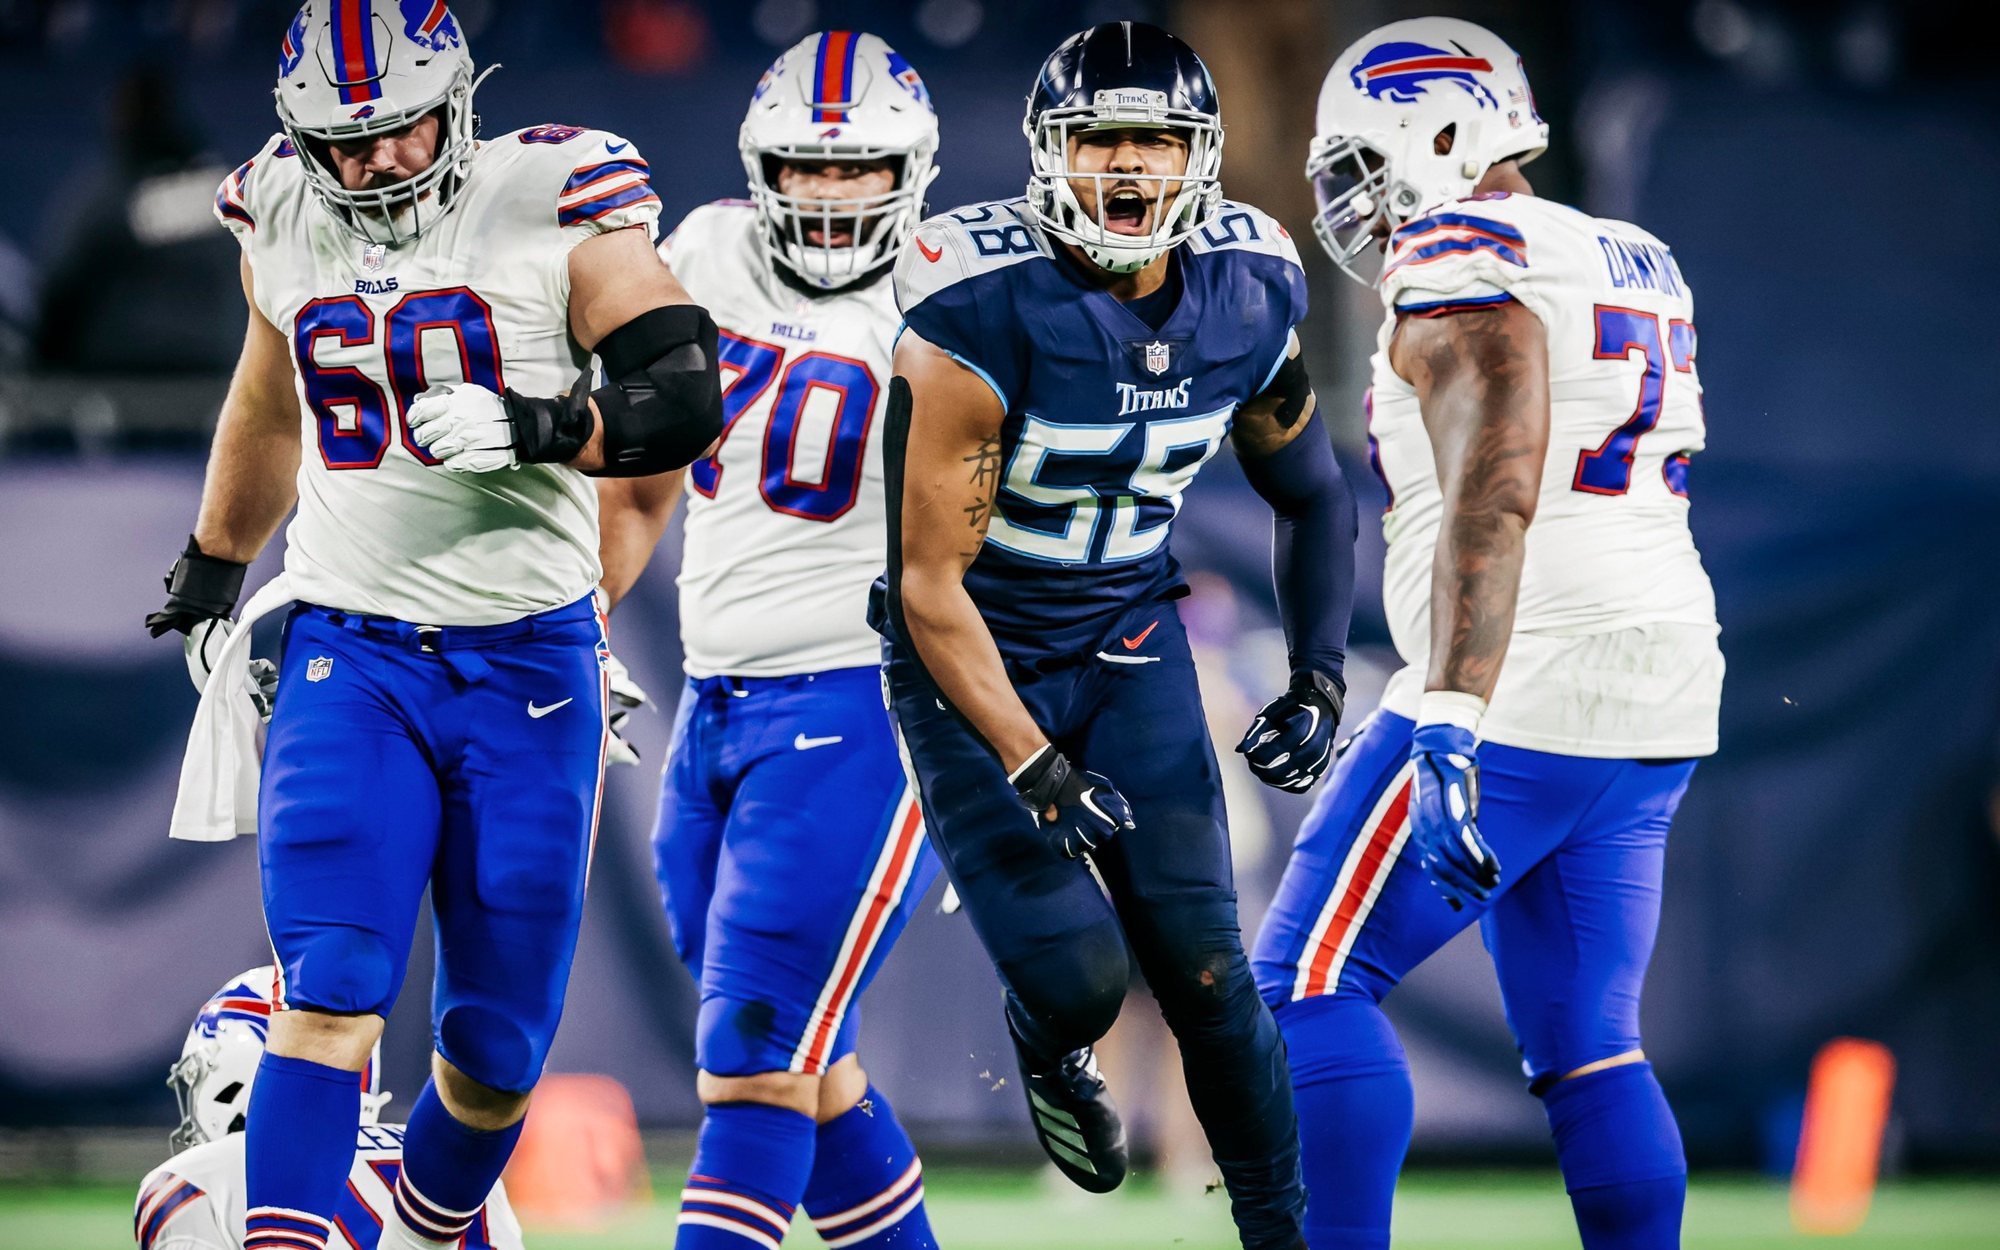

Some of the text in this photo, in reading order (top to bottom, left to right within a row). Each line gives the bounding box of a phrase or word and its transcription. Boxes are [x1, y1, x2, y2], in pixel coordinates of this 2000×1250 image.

[1115, 92, 1149, 105] TITANS
[1199, 201, 1262, 251] 5
[354, 276, 399, 295] BILLS
[771, 322, 817, 341] BILLS
[294, 285, 504, 470] 60
[1115, 376, 1193, 417] TITANS
[691, 326, 881, 523] 70
[985, 400, 1238, 564] 58
